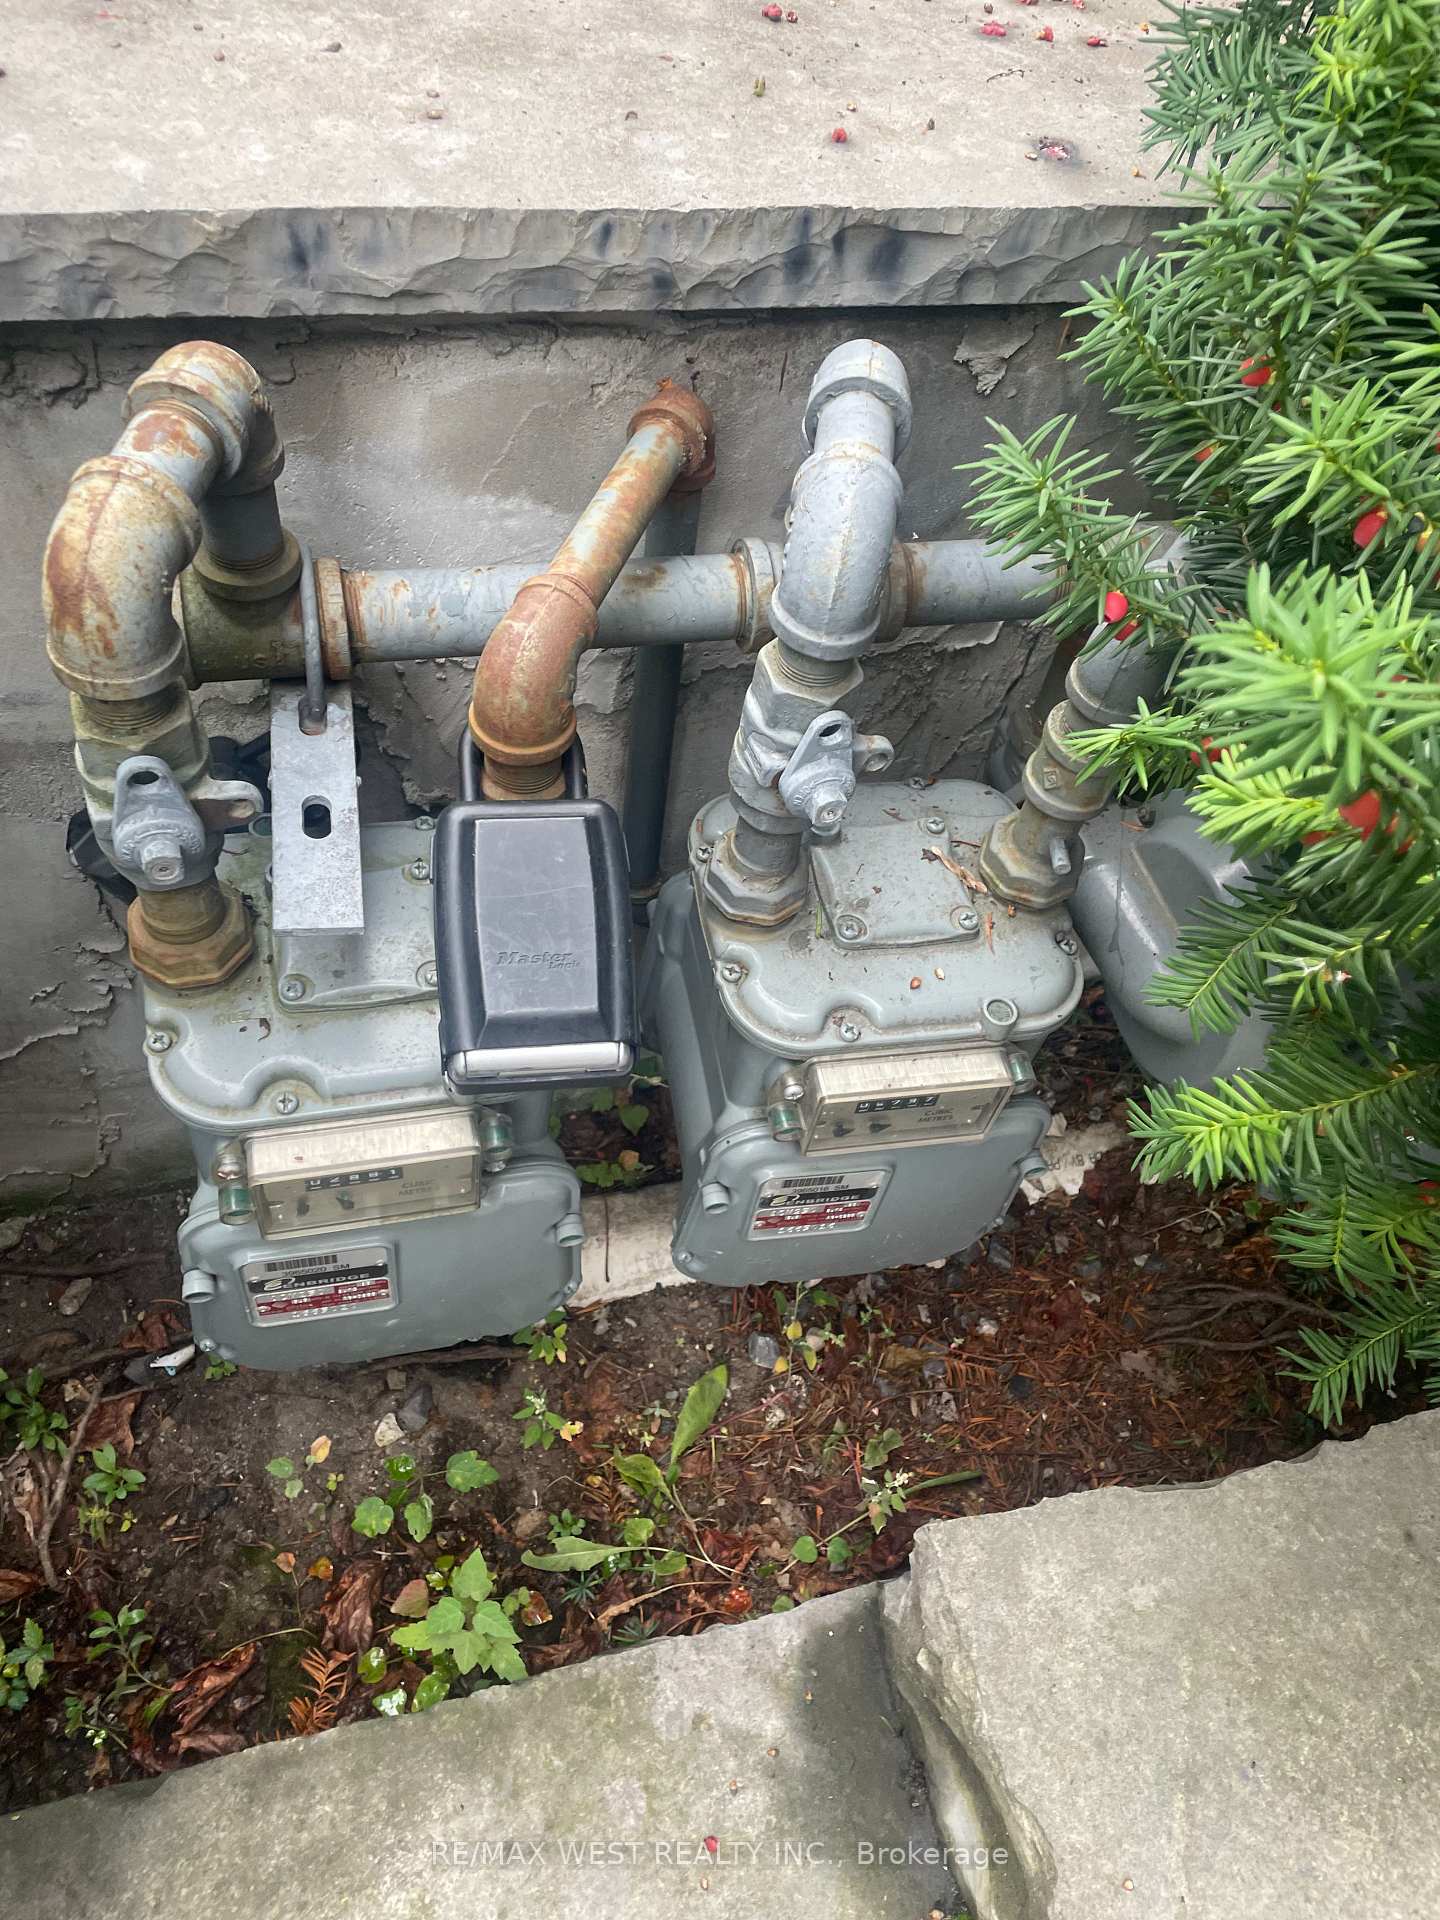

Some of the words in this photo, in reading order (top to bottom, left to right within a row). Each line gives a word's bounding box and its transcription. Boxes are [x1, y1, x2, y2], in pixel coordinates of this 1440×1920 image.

[497, 951, 572, 965] Master
[786, 1194, 861, 1206] ENBRIDGE
[282, 1272, 370, 1290] ENBRIDGE
